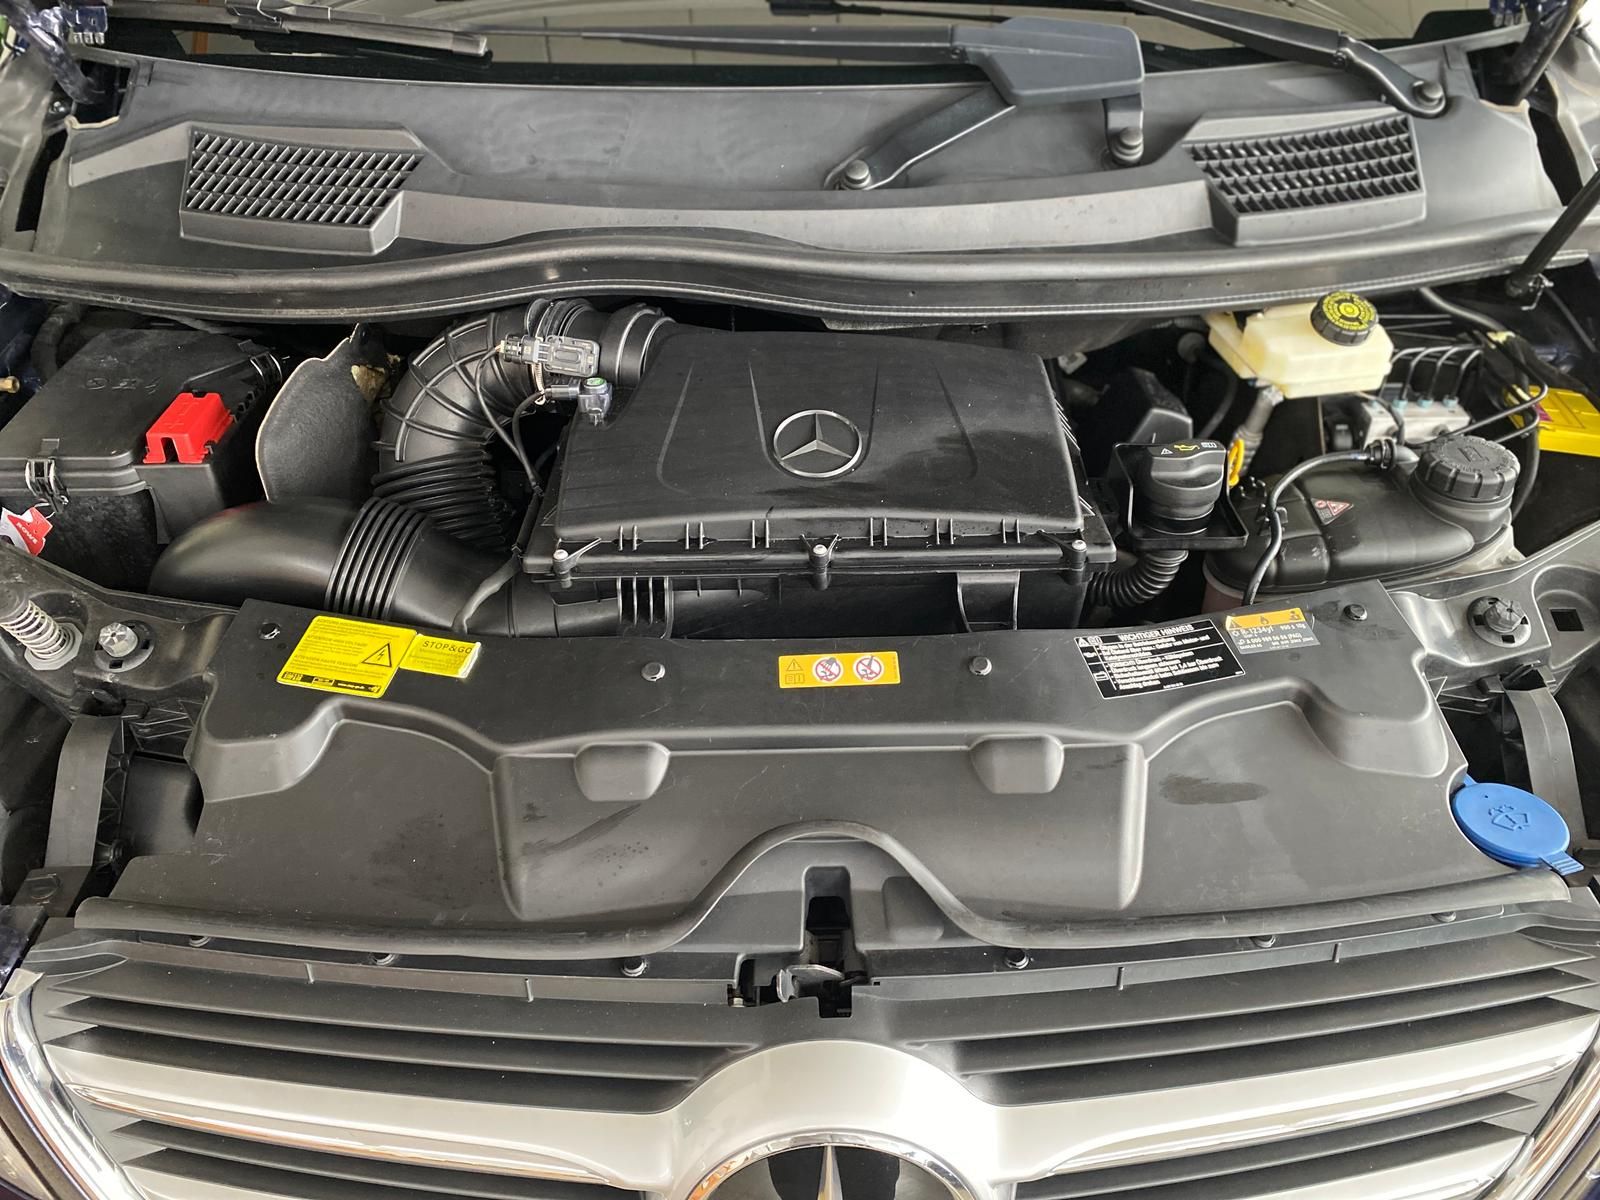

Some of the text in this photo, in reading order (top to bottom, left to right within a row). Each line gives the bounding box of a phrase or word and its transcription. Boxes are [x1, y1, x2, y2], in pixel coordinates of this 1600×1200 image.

[15, 522, 38, 544] ROWE
[1118, 625, 1194, 641] WICHTIGER HINWEIS
[422, 640, 473, 654] STOP&GO
